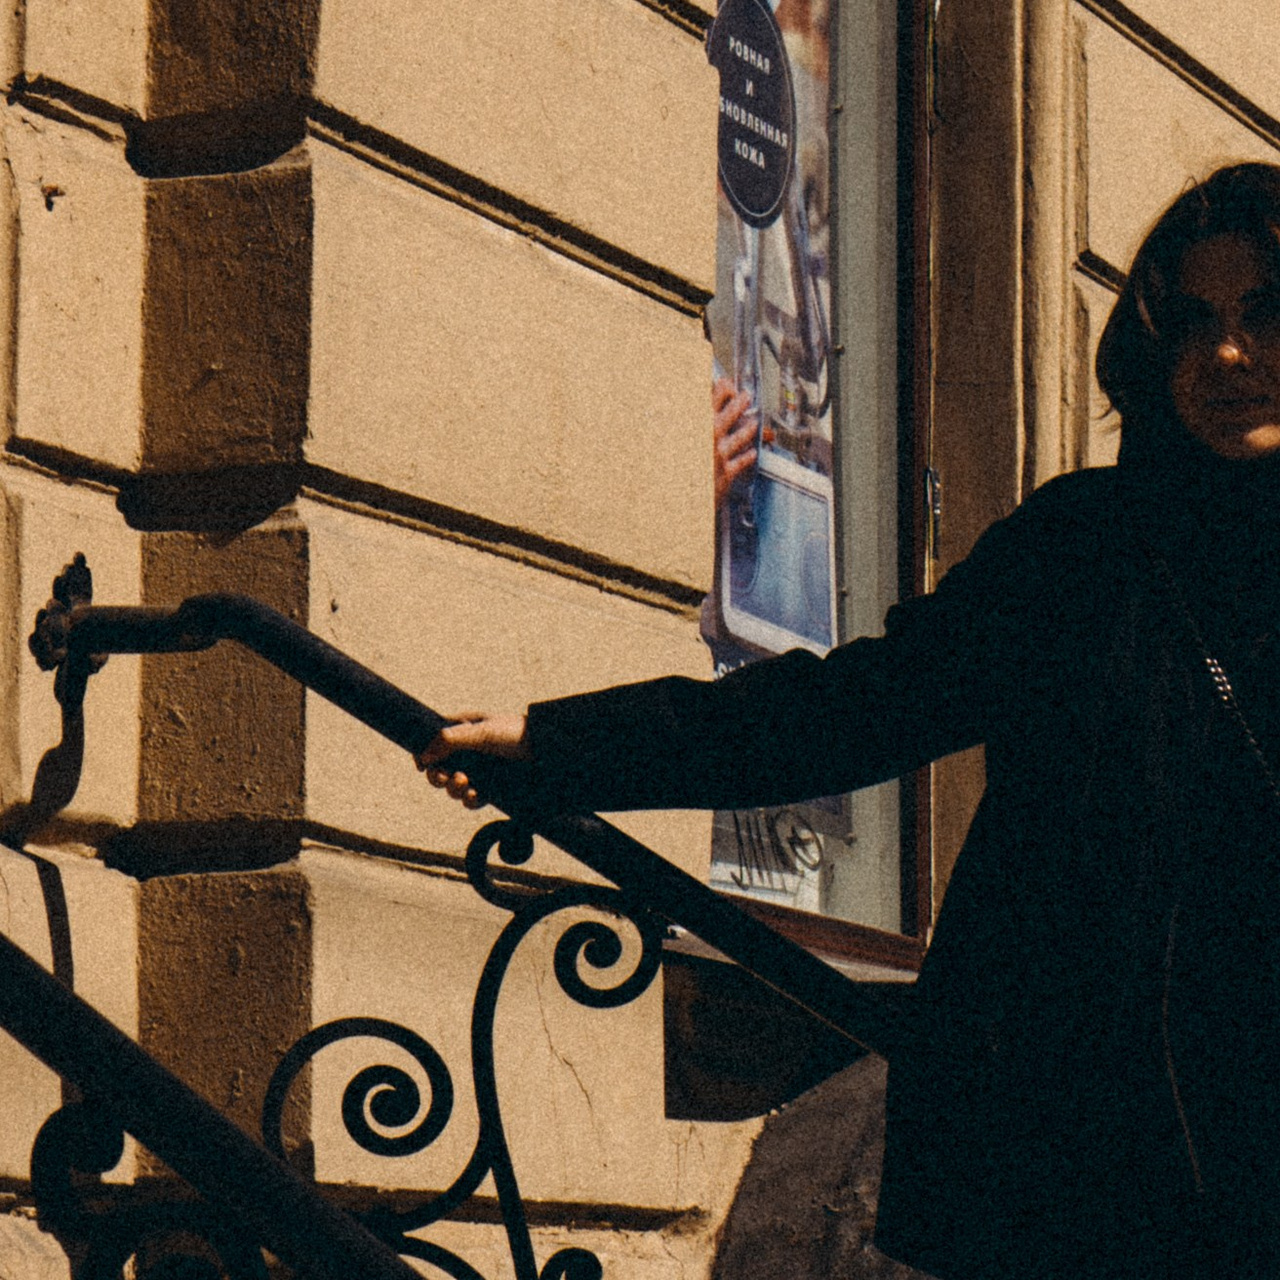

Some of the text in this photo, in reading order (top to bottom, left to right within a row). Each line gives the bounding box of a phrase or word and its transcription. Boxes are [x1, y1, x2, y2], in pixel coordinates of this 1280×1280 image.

[728, 36, 770, 75] РОВНАЯ
[745, 78, 754, 97] И
[734, 137, 766, 170] КОЖА
